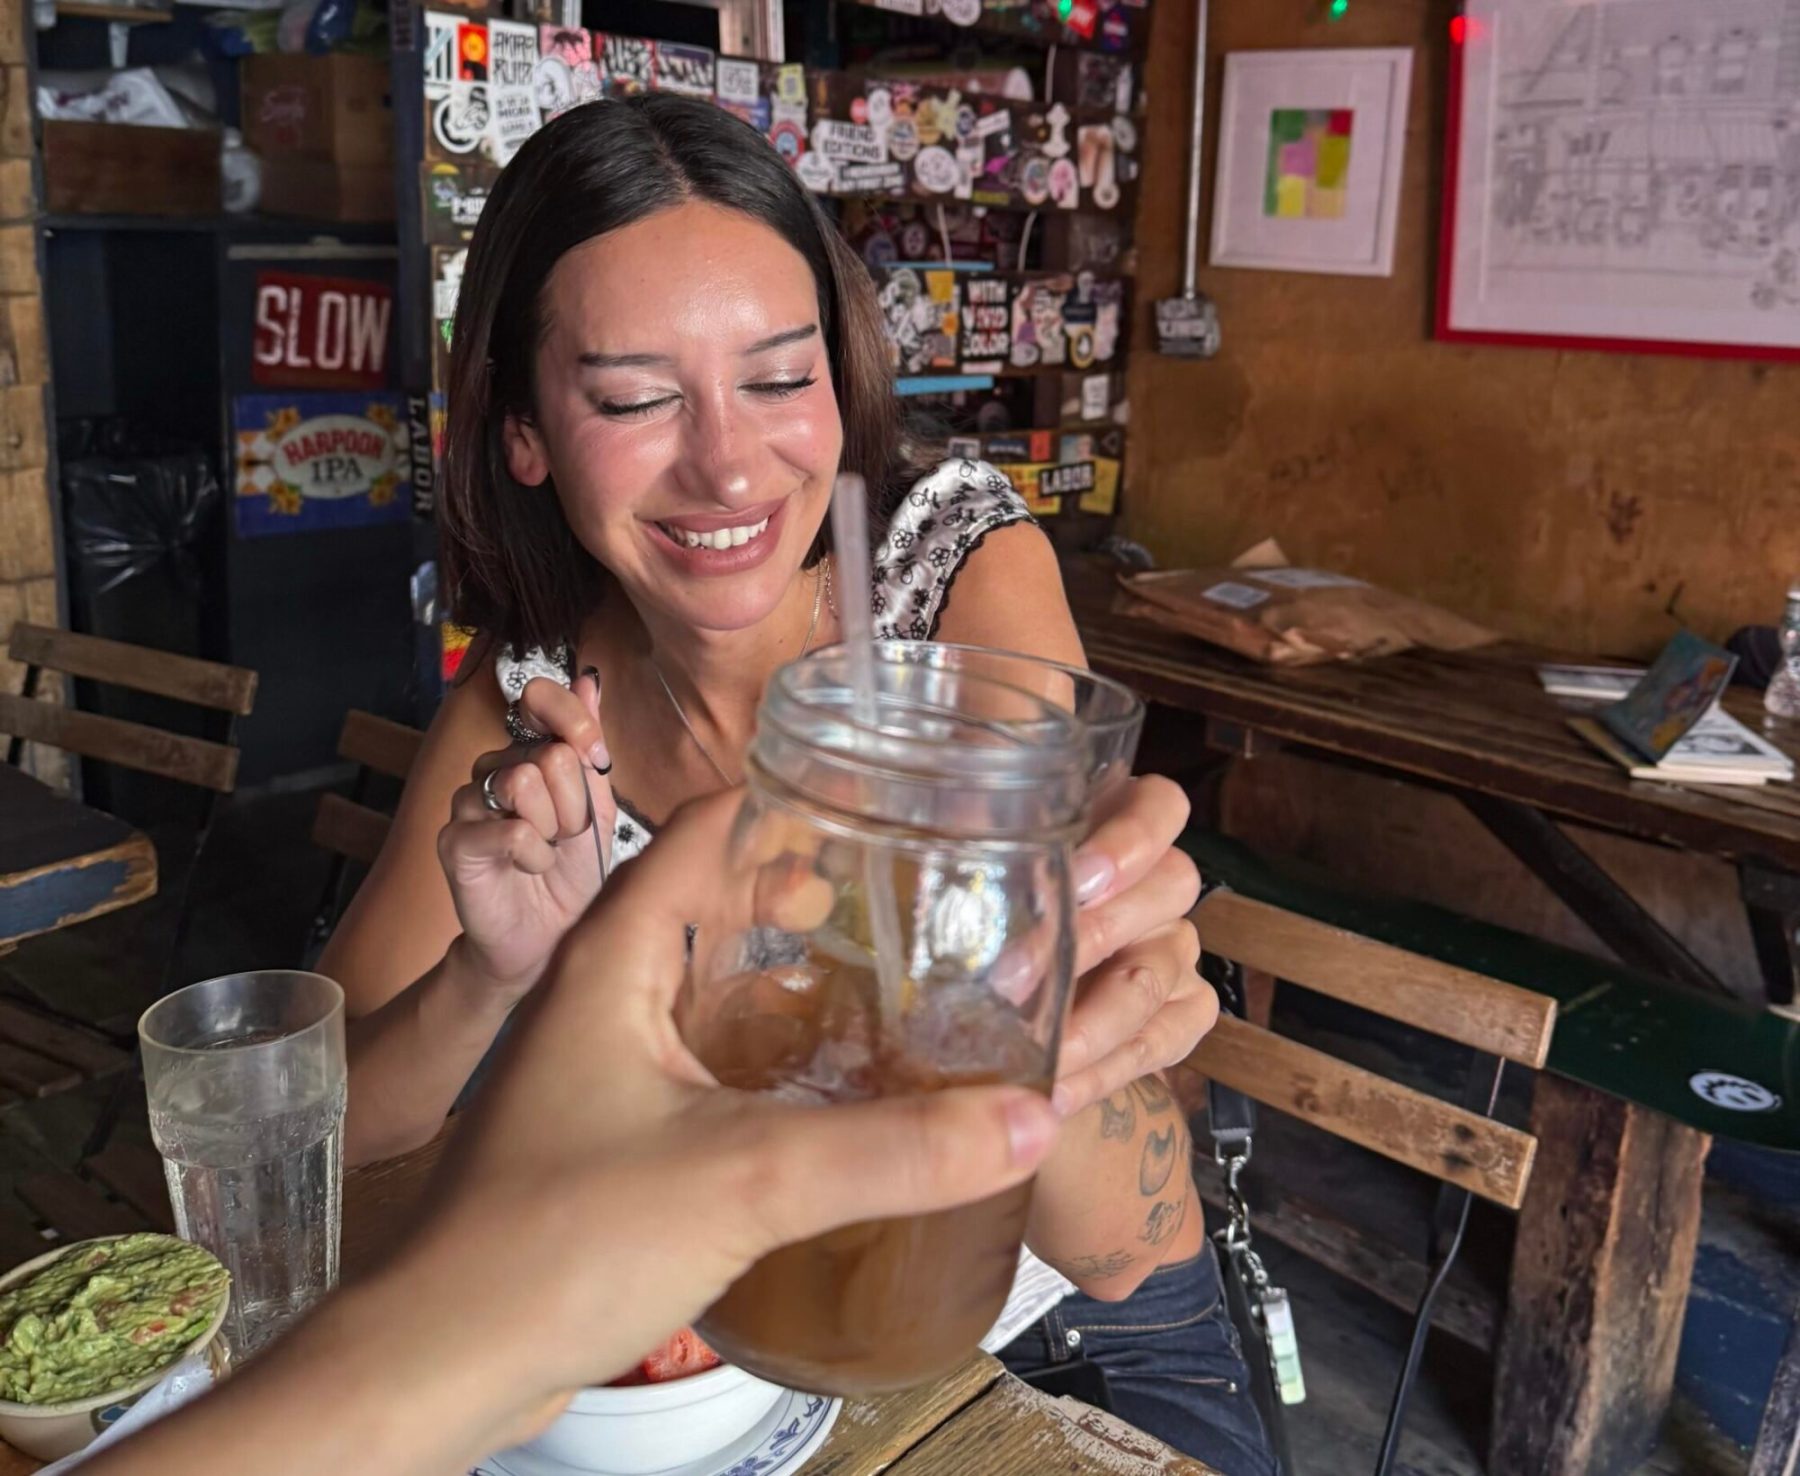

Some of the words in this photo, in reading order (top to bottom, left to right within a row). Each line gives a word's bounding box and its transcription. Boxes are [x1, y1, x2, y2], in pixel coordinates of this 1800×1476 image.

[255, 286, 391, 371] SLOW
[282, 429, 386, 465] HARPOON
[310, 457, 364, 483] IPA
[1041, 464, 1093, 494] LABOR
